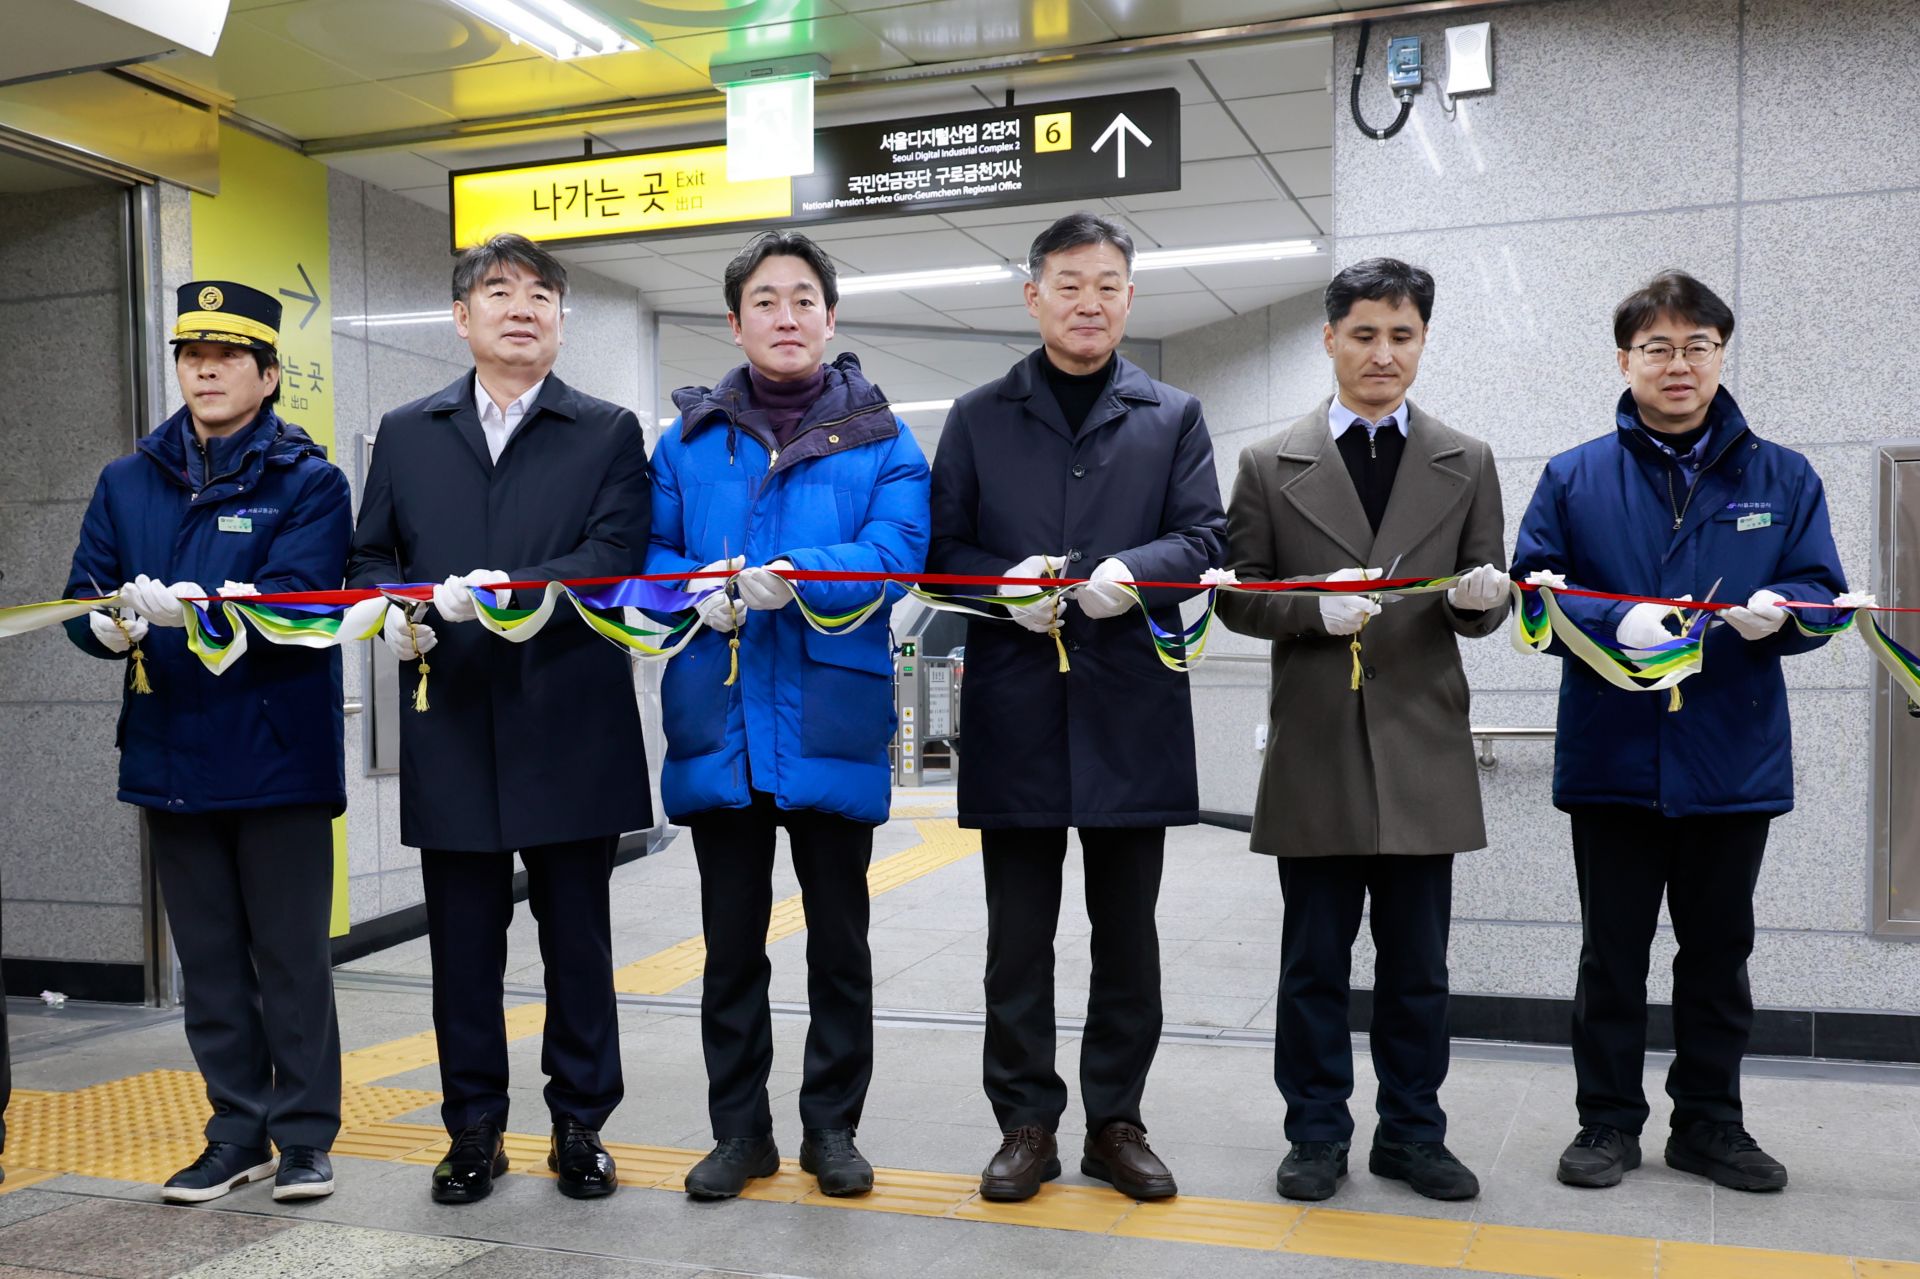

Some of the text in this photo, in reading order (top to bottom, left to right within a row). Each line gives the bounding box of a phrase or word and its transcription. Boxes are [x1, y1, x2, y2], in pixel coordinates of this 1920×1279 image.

[880, 118, 1021, 151] 서울디지털산업 2단지
[1045, 121, 1061, 144] 6
[892, 141, 1021, 164] Seoul Digital Industrial Complex 2
[676, 170, 706, 188] Exit
[848, 158, 1022, 195] 국민연금공단 구로금천지사
[533, 172, 669, 221] 나가는 곳
[676, 195, 704, 212] 出口
[802, 180, 1022, 211] National Pension Service Guro-Geumcheon Regional Office
[307, 361, 325, 394] 곳
[290, 394, 309, 410] 出口
